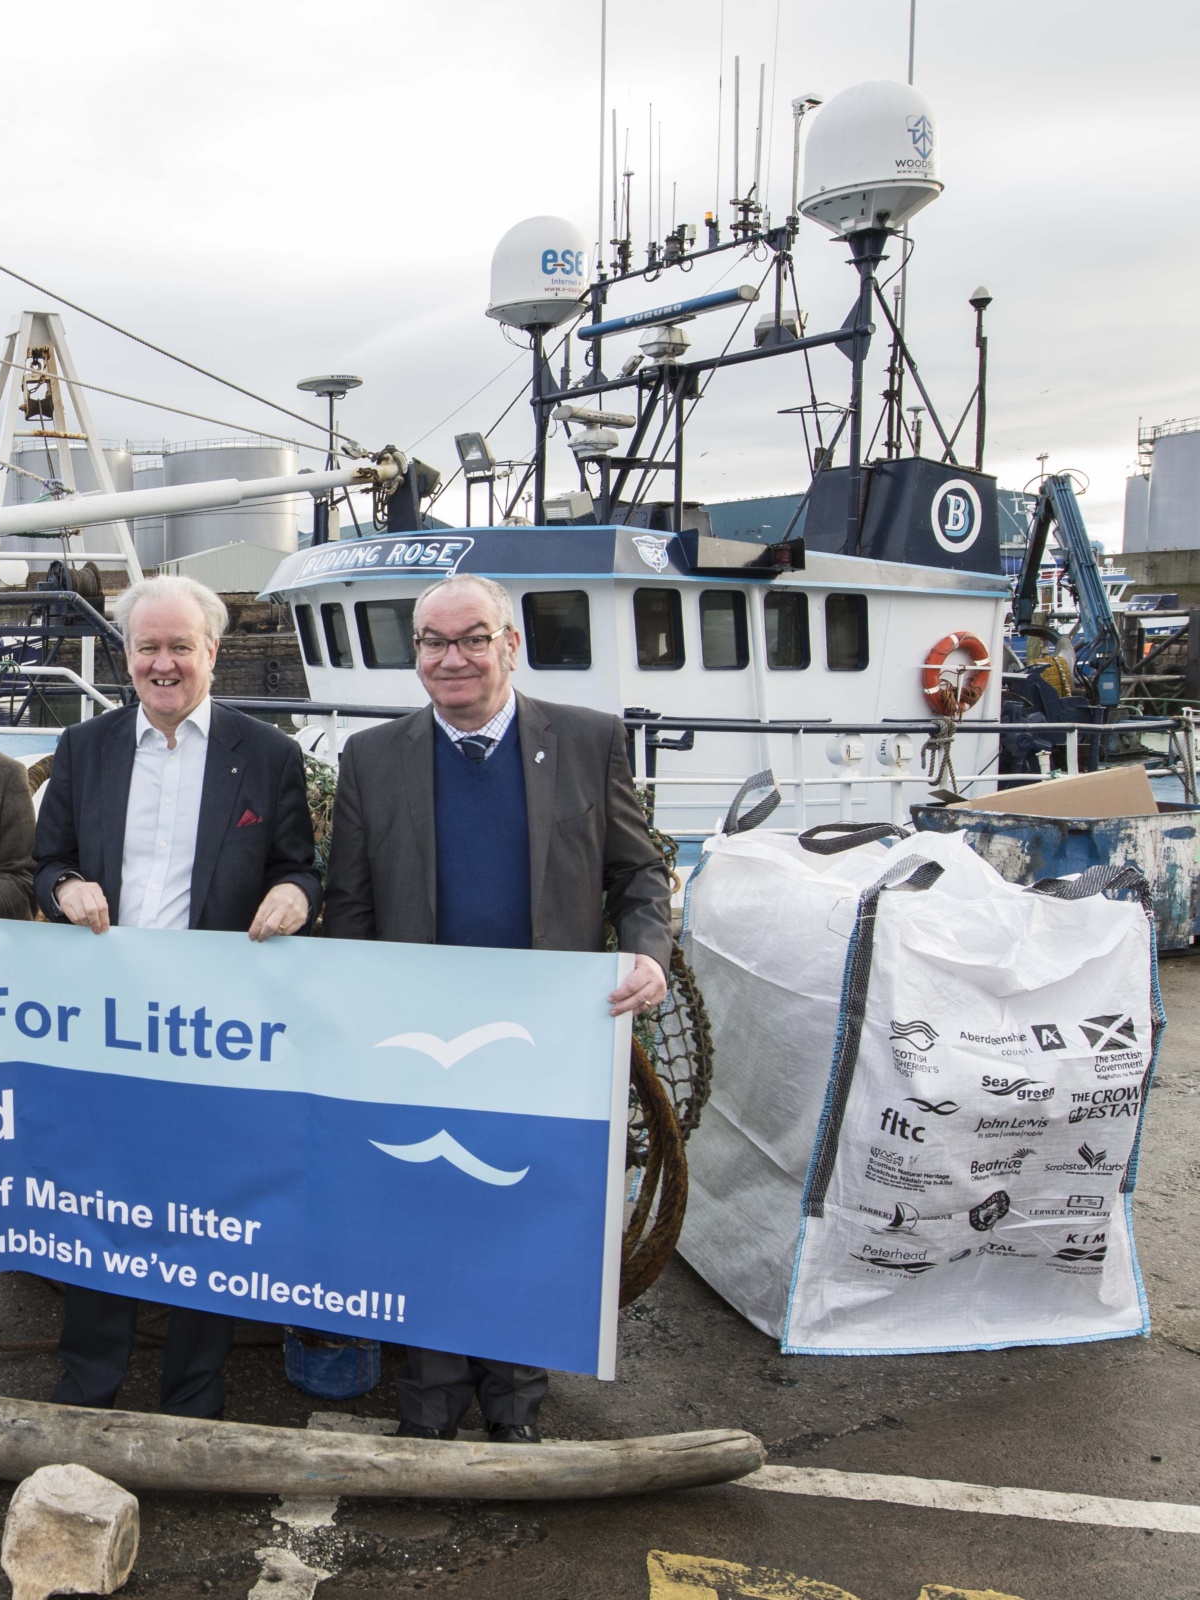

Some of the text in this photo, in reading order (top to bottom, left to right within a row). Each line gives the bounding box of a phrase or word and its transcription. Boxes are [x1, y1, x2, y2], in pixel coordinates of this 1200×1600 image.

[895, 159, 934, 169] WOODS
[625, 303, 682, 324] FURUNO
[944, 494, 970, 537] B
[302, 542, 463, 575] BUDDING ROSE
[1, 653, 15, 661] 151
[880, 738, 888, 757] VENT
[104, 997, 288, 1062] Litter
[1095, 1050, 1143, 1064] The Scottish
[1094, 1059, 1144, 1073] Government
[981, 1075, 1009, 1087] Sea
[1017, 1087, 1055, 1100] green
[1071, 1092, 1091, 1103] THE
[880, 1107, 926, 1143] fltc
[973, 1116, 1049, 1132] John Lewis
[868, 1157, 950, 1180] Scottish Natural Heritage
[970, 1157, 1023, 1175] Beatrice
[25, 1177, 154, 1229] Marine
[167, 1201, 262, 1245] litter
[859, 1204, 894, 1220] TARBERT
[862, 1244, 928, 1261] Peterhead
[102, 1248, 198, 1288] we’ve
[208, 1269, 406, 1323] collected!!!
